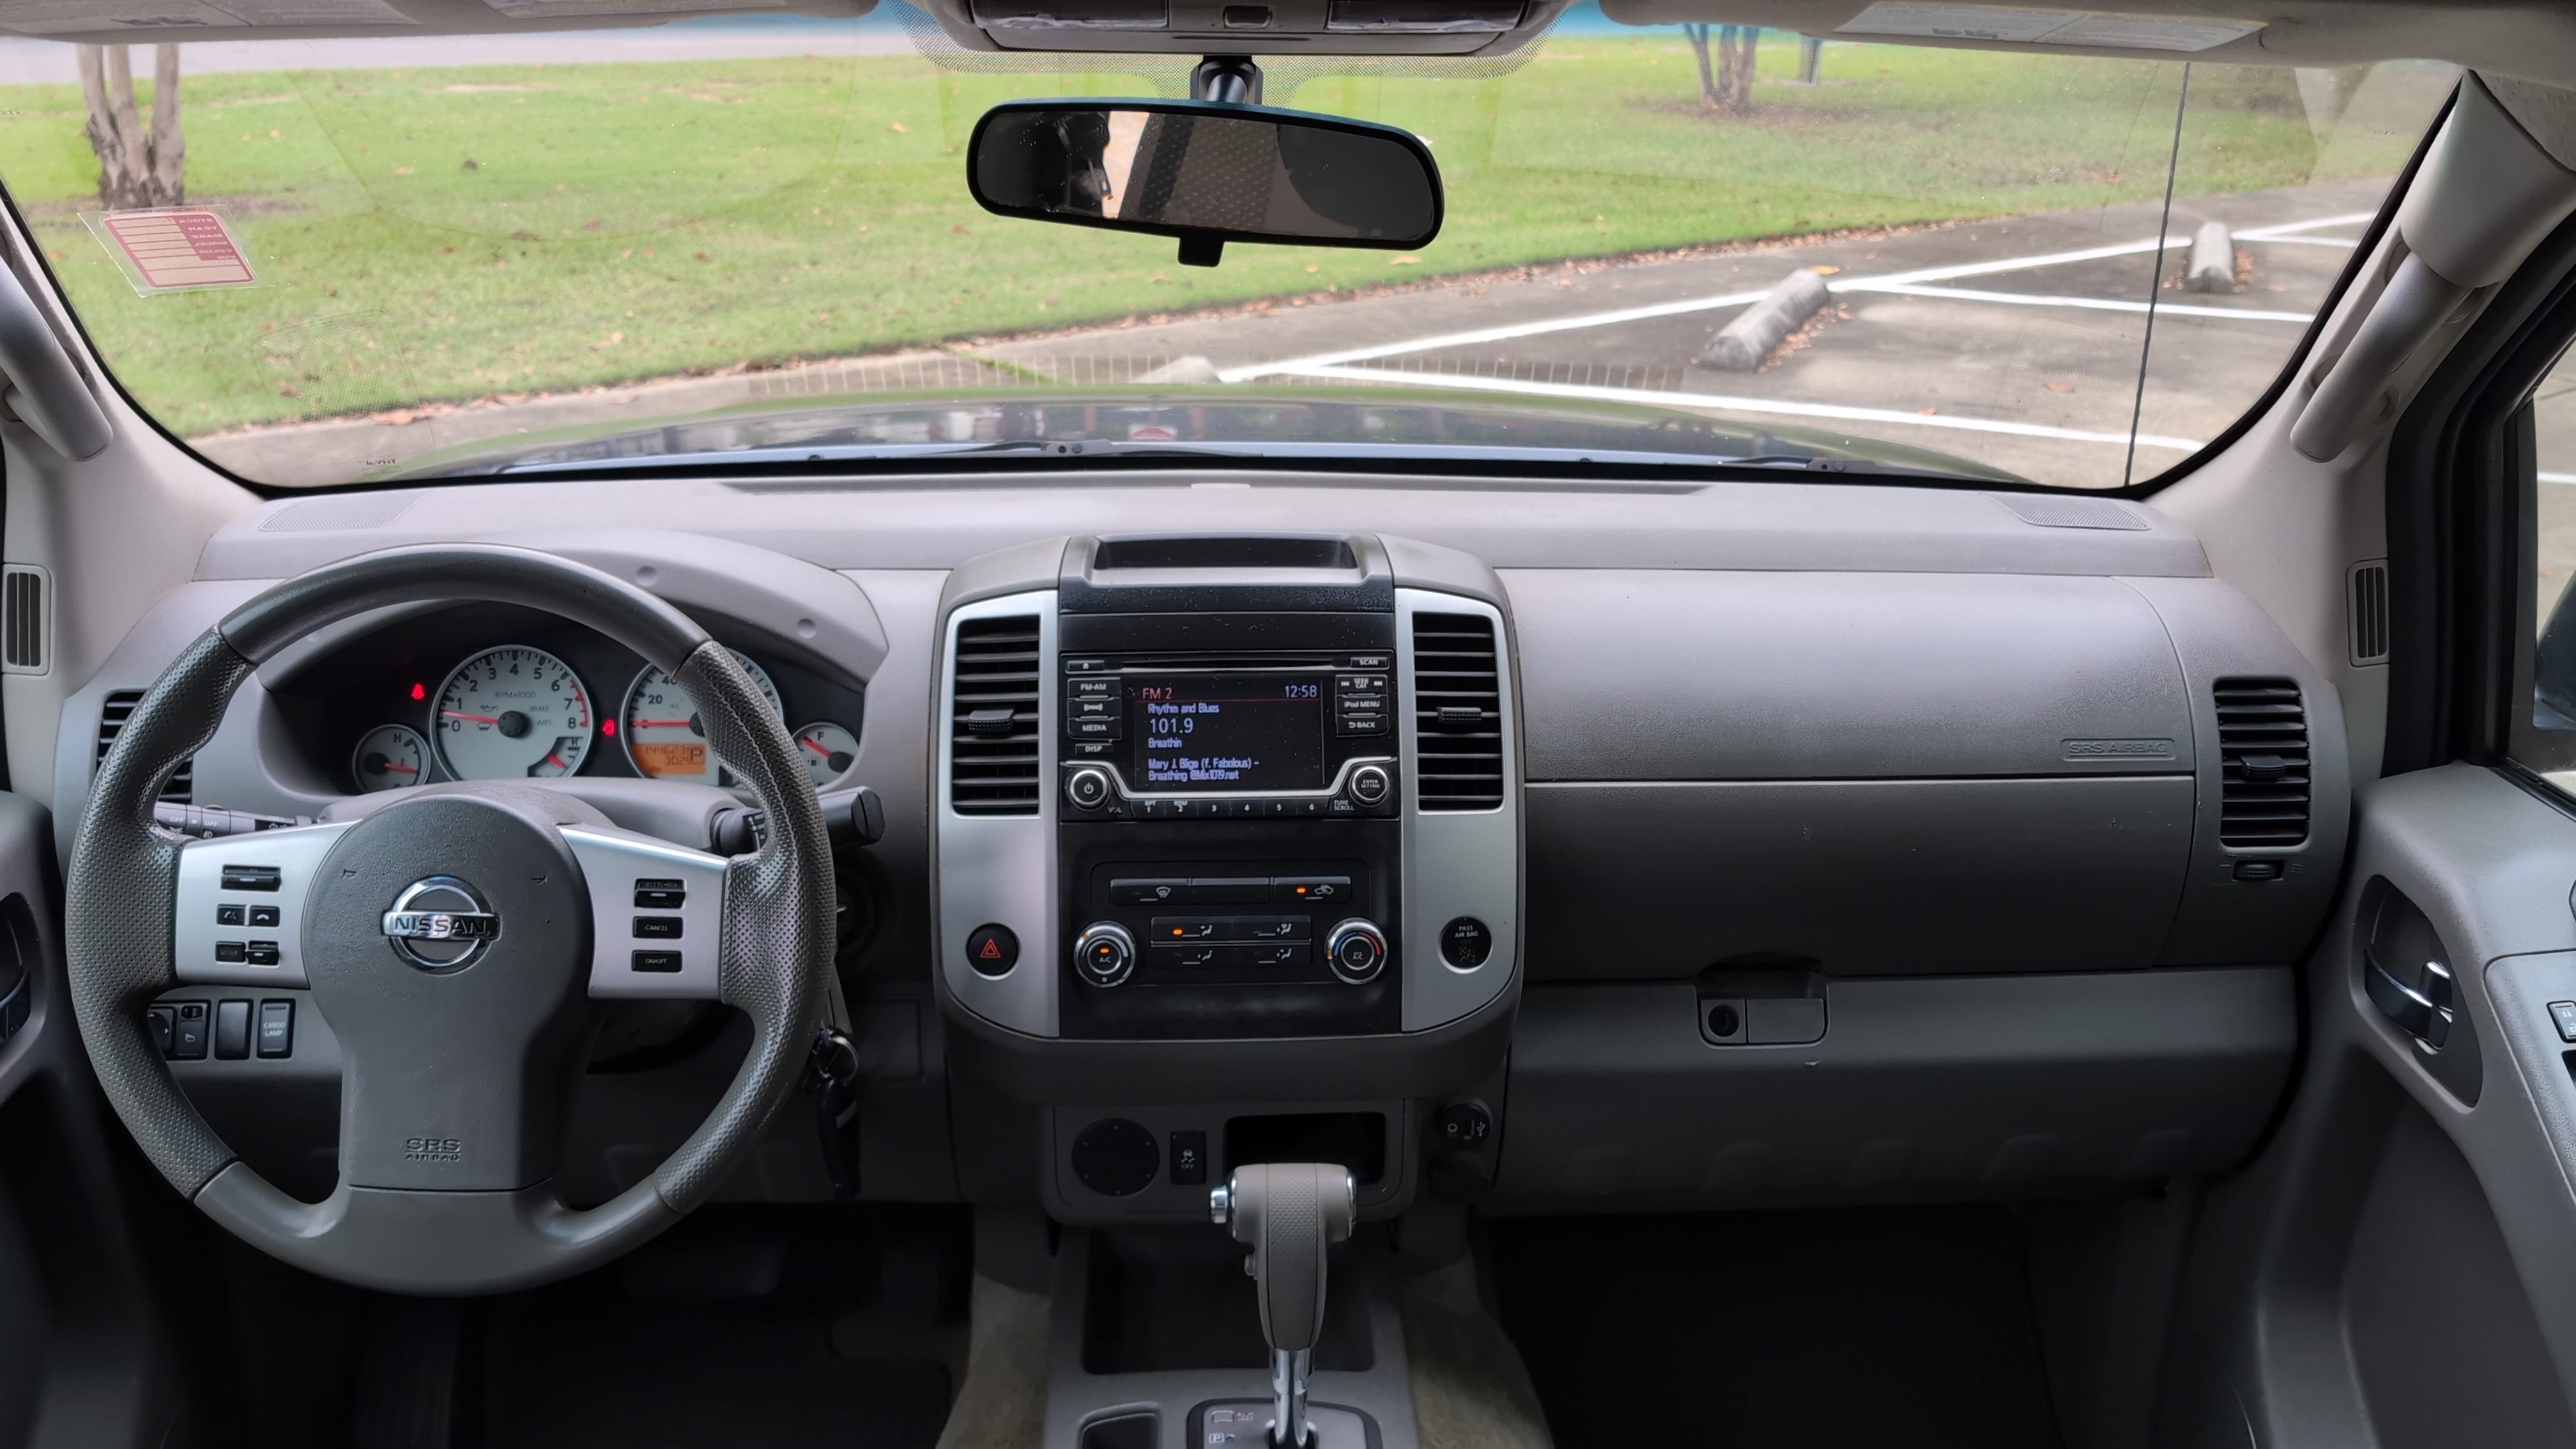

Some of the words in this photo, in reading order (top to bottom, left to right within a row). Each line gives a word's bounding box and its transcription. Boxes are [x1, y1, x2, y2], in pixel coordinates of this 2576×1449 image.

[487, 667, 497, 680] 3
[509, 663, 519, 676] 4
[533, 667, 542, 680] 5
[468, 679, 479, 693] 2
[551, 679, 561, 692] 6
[1285, 684, 1317, 698] 12:58
[648, 694, 663, 704] 20
[1142, 687, 1161, 700] FM
[1165, 687, 1173, 699] 2
[456, 697, 463, 710] 1
[564, 698, 573, 710] 7
[1147, 703, 1179, 715] Rhythm
[1181, 703, 1197, 713] and
[1198, 703, 1220, 714] Blues
[452, 719, 461, 732] 0
[567, 717, 576, 730] 8
[1149, 717, 1194, 734] 101.9
[394, 733, 402, 743] H
[818, 732, 824, 741] F
[1148, 737, 1183, 748] Breathin
[2068, 742, 2104, 754] SRS
[1147, 758, 1169, 770] Mary
[394, 917, 487, 935] NISSAN
[406, 1138, 461, 1153] SRS
